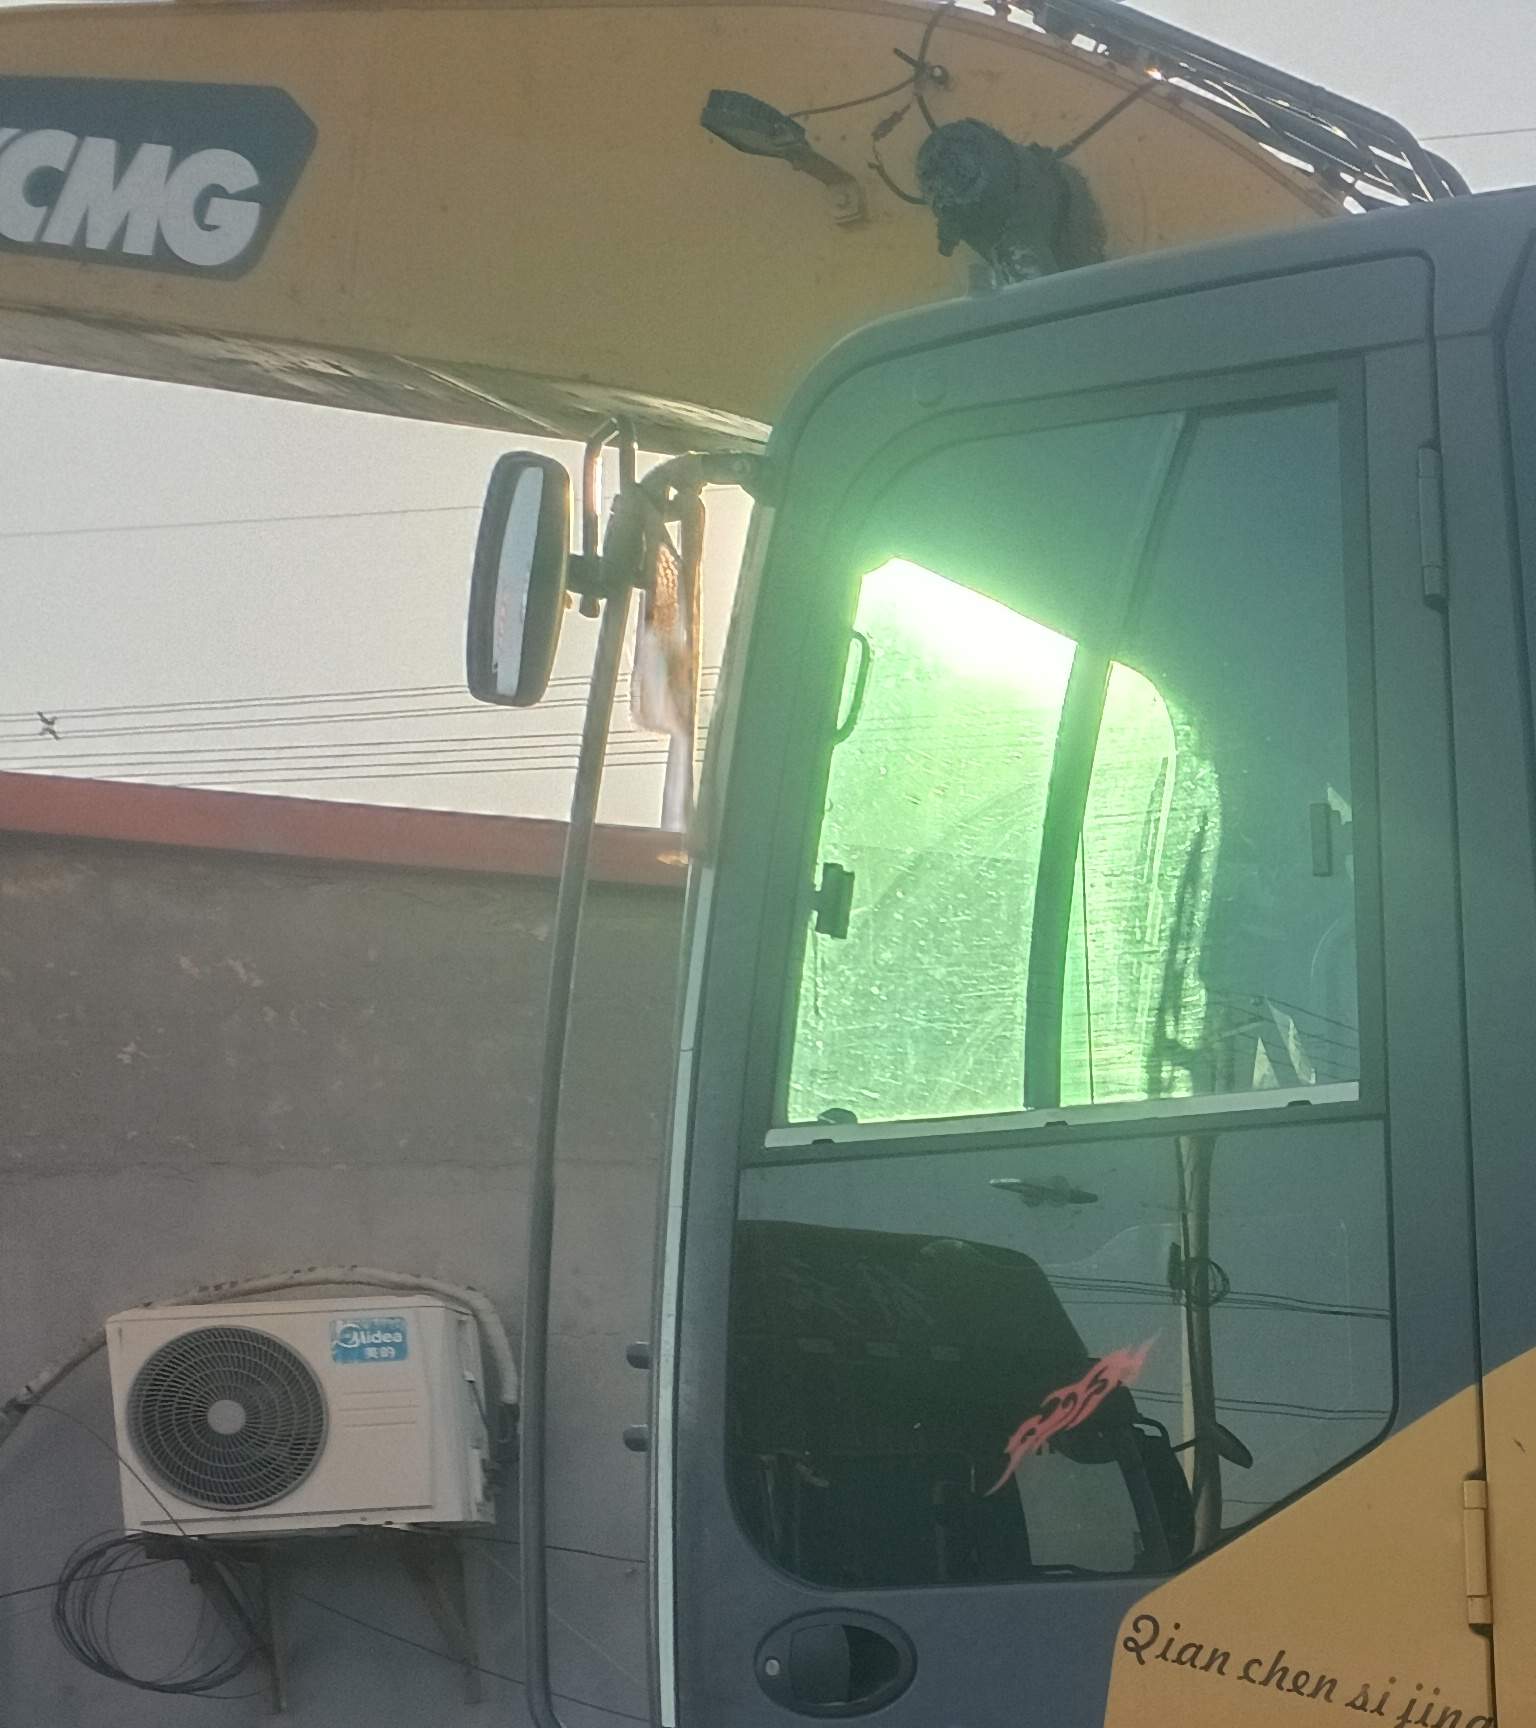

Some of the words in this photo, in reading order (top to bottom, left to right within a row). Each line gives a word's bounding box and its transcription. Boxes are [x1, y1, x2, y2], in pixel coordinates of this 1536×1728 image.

[0, 127, 260, 266] CMG
[335, 1323, 402, 1348] Midea
[1122, 1613, 1232, 1676] Qian
[1236, 1649, 1338, 1704] chen
[1345, 1676, 1397, 1717] si
